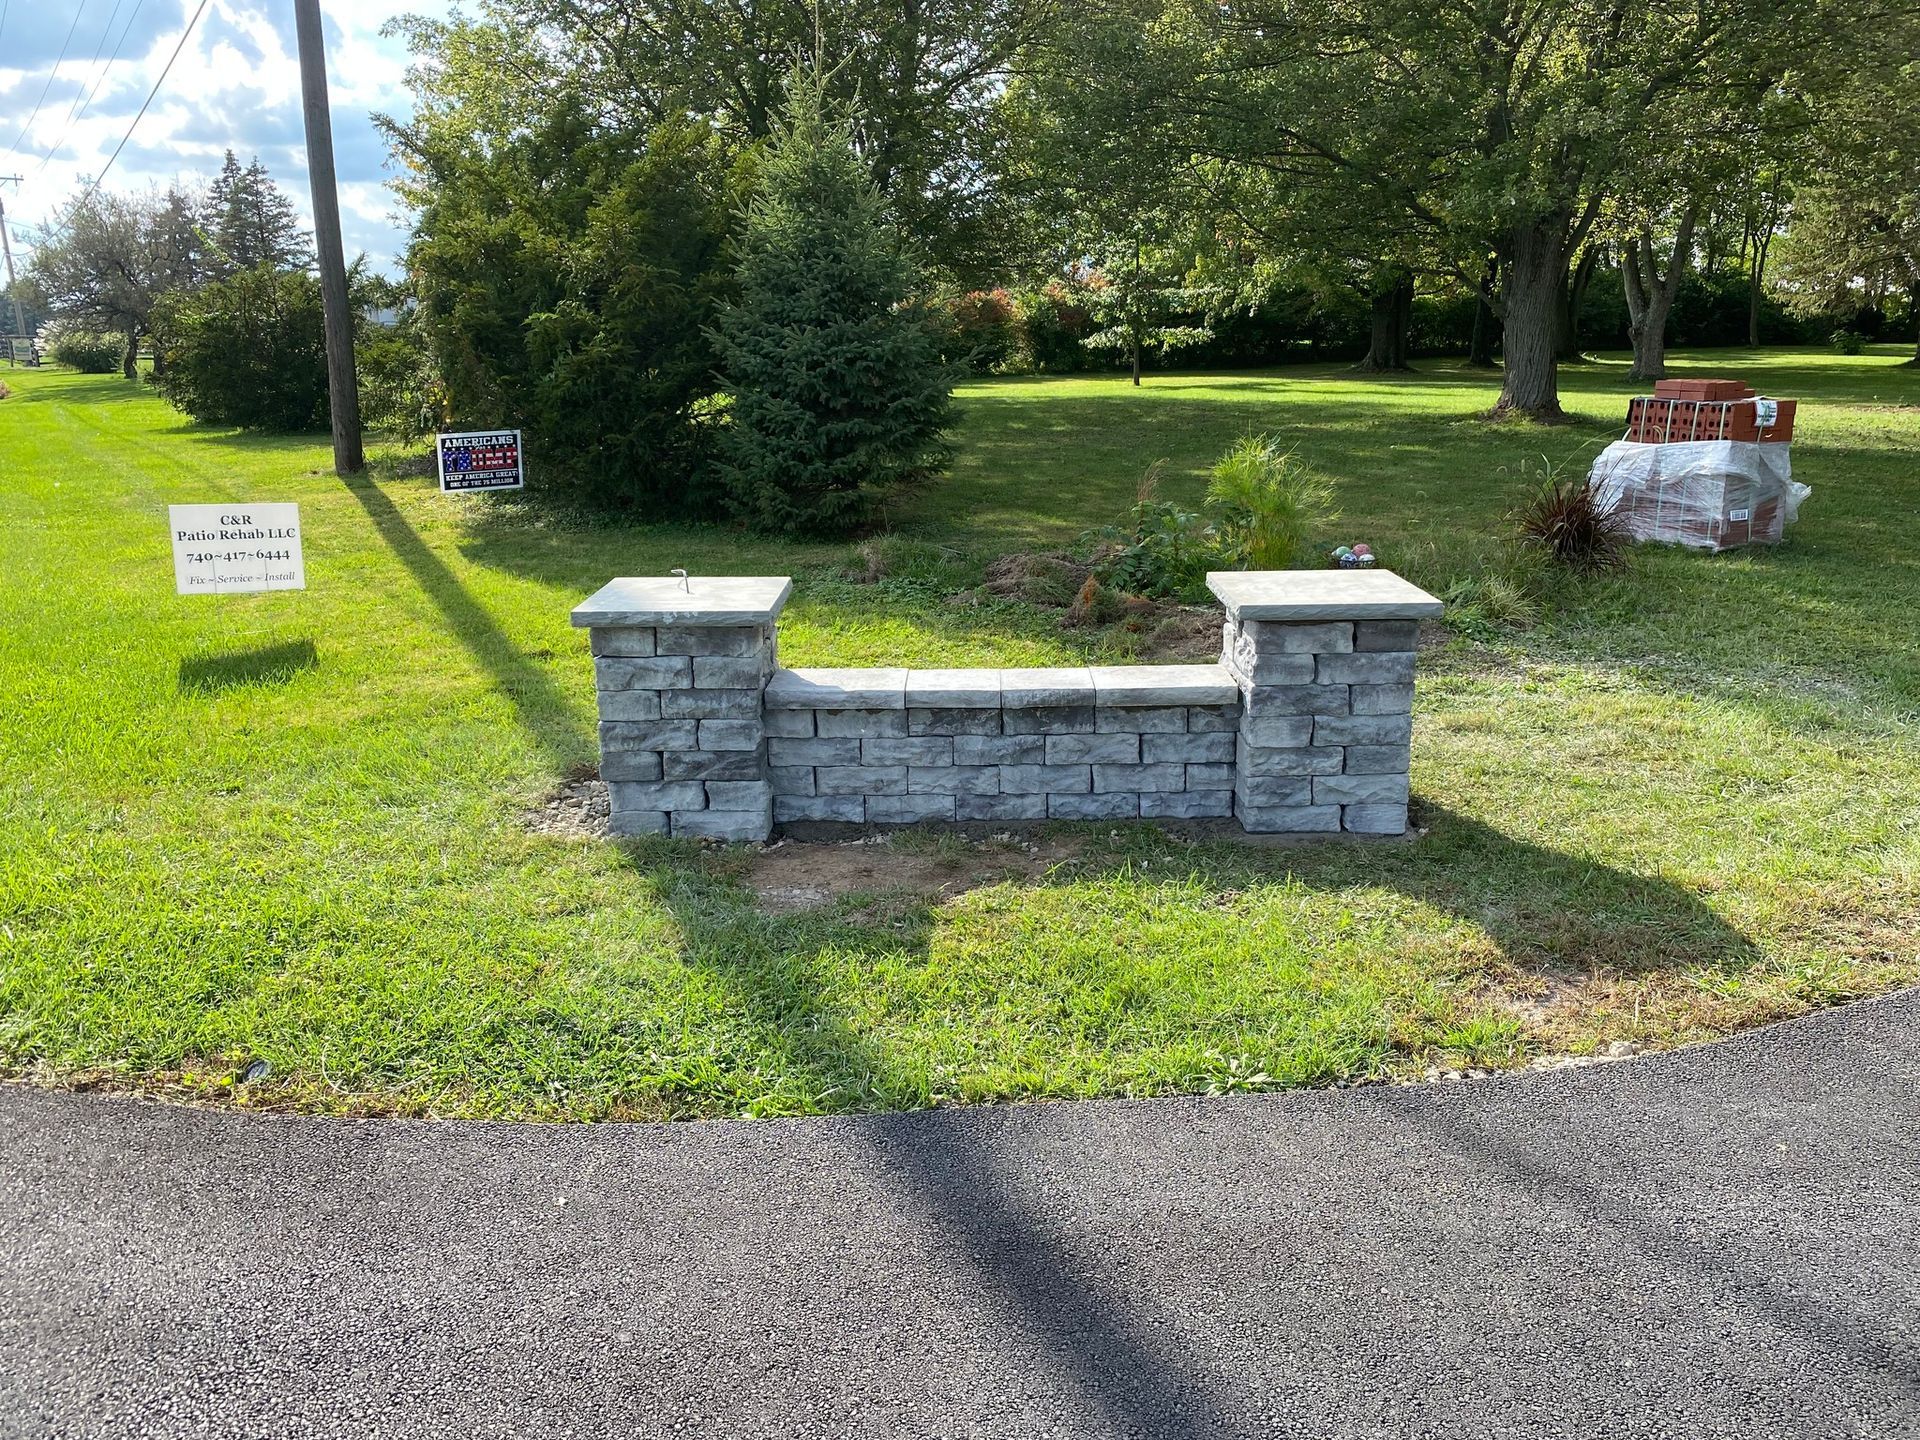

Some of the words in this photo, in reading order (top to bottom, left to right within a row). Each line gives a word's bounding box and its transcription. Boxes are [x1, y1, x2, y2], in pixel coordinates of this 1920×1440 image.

[444, 436, 514, 448] AMERICANS
[442, 448, 518, 472] TRUMP
[220, 514, 252, 526] C&R
[177, 530, 215, 541] Patio
[220, 528, 264, 540] Rehab
[268, 528, 296, 538] LLC
[189, 576, 206, 585] Fix
[217, 574, 253, 584] Service
[264, 572, 295, 581] Install
